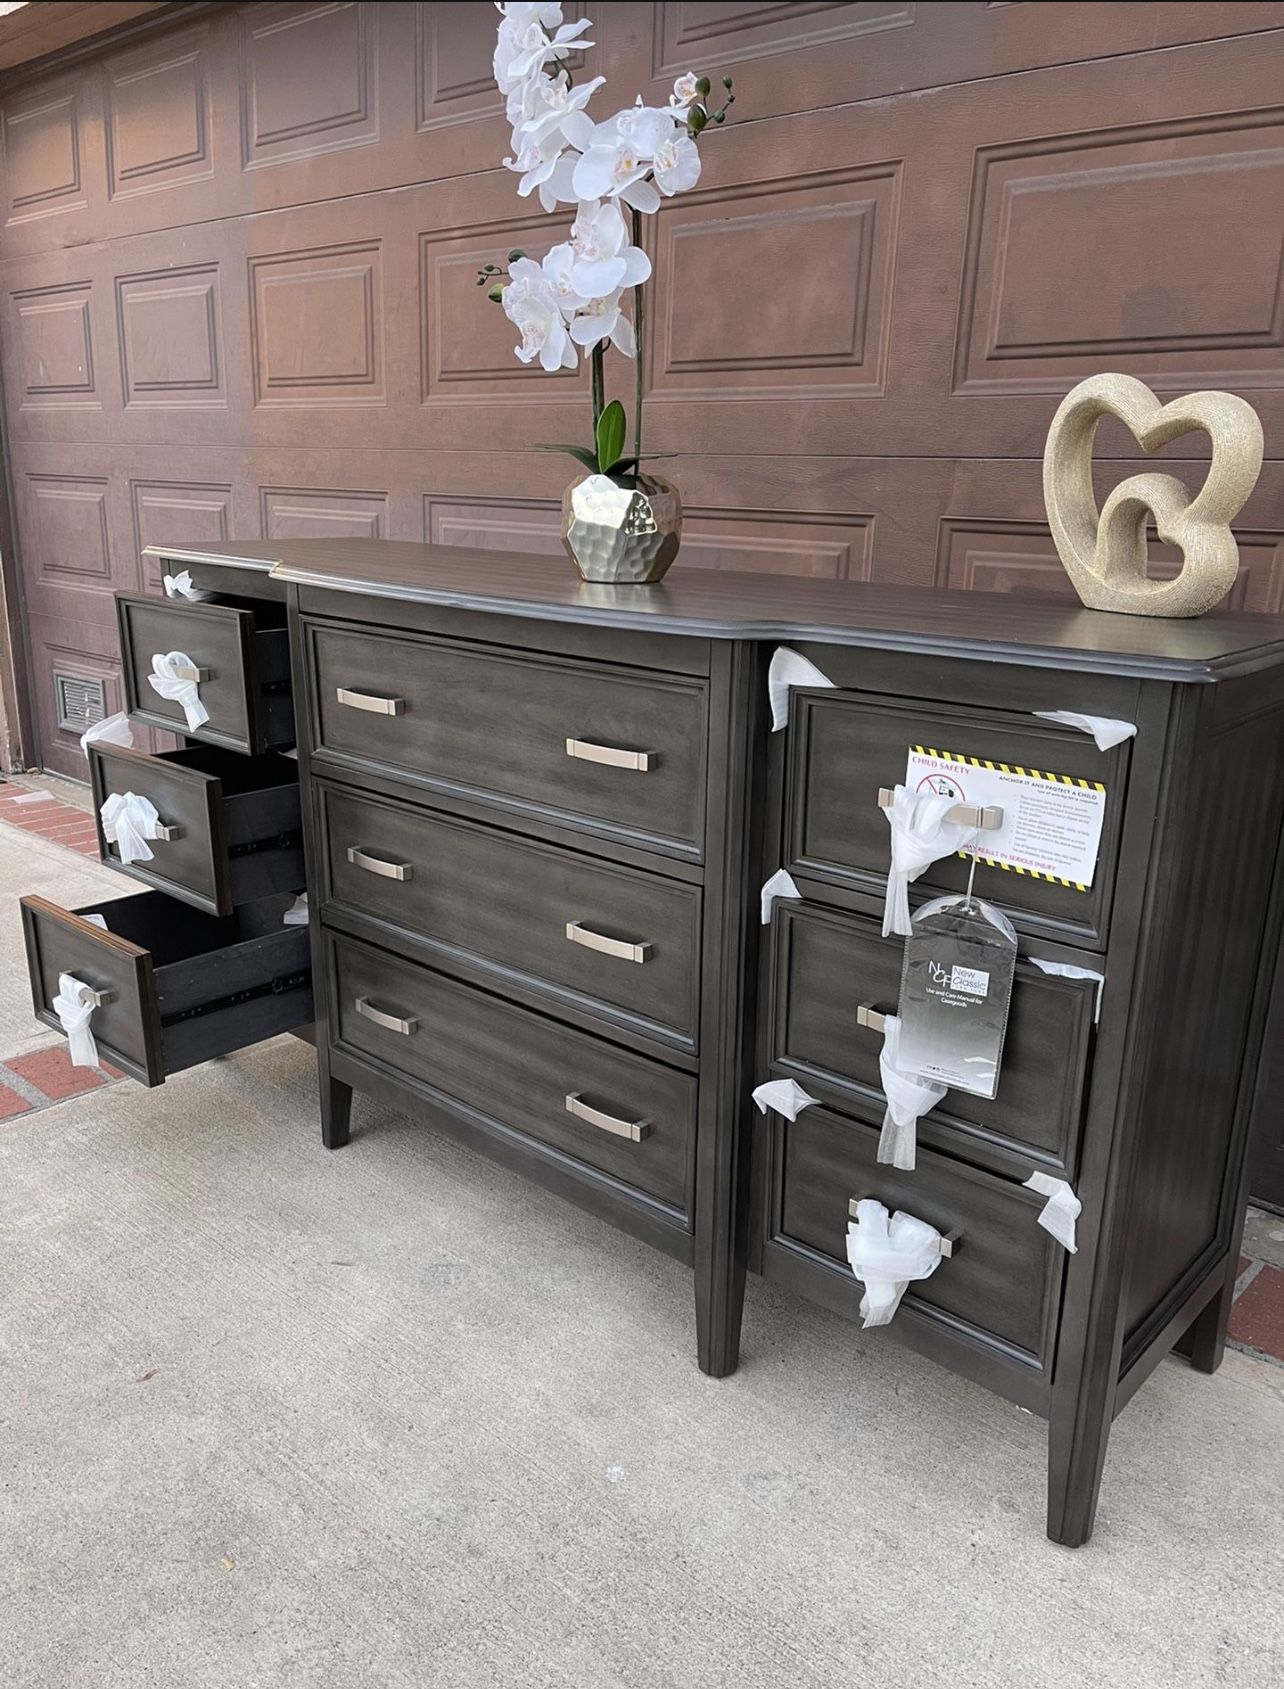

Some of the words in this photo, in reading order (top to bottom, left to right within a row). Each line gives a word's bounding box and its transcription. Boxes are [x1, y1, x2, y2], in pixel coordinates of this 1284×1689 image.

[912, 756, 938, 768] CHILD
[940, 763, 969, 775] SAFETY
[999, 776, 1023, 784] ANCHOR
[1045, 785, 1071, 794] PROTECT
[1077, 792, 1097, 800] CHILD
[977, 847, 999, 857] RESULT
[1009, 854, 1034, 865] SERIOUS
[1034, 861, 1056, 871] INJURY
[953, 967, 976, 978] New
[952, 976, 987, 990] Classic
[945, 991, 956, 999] Care
[957, 994, 975, 1003] Manual
